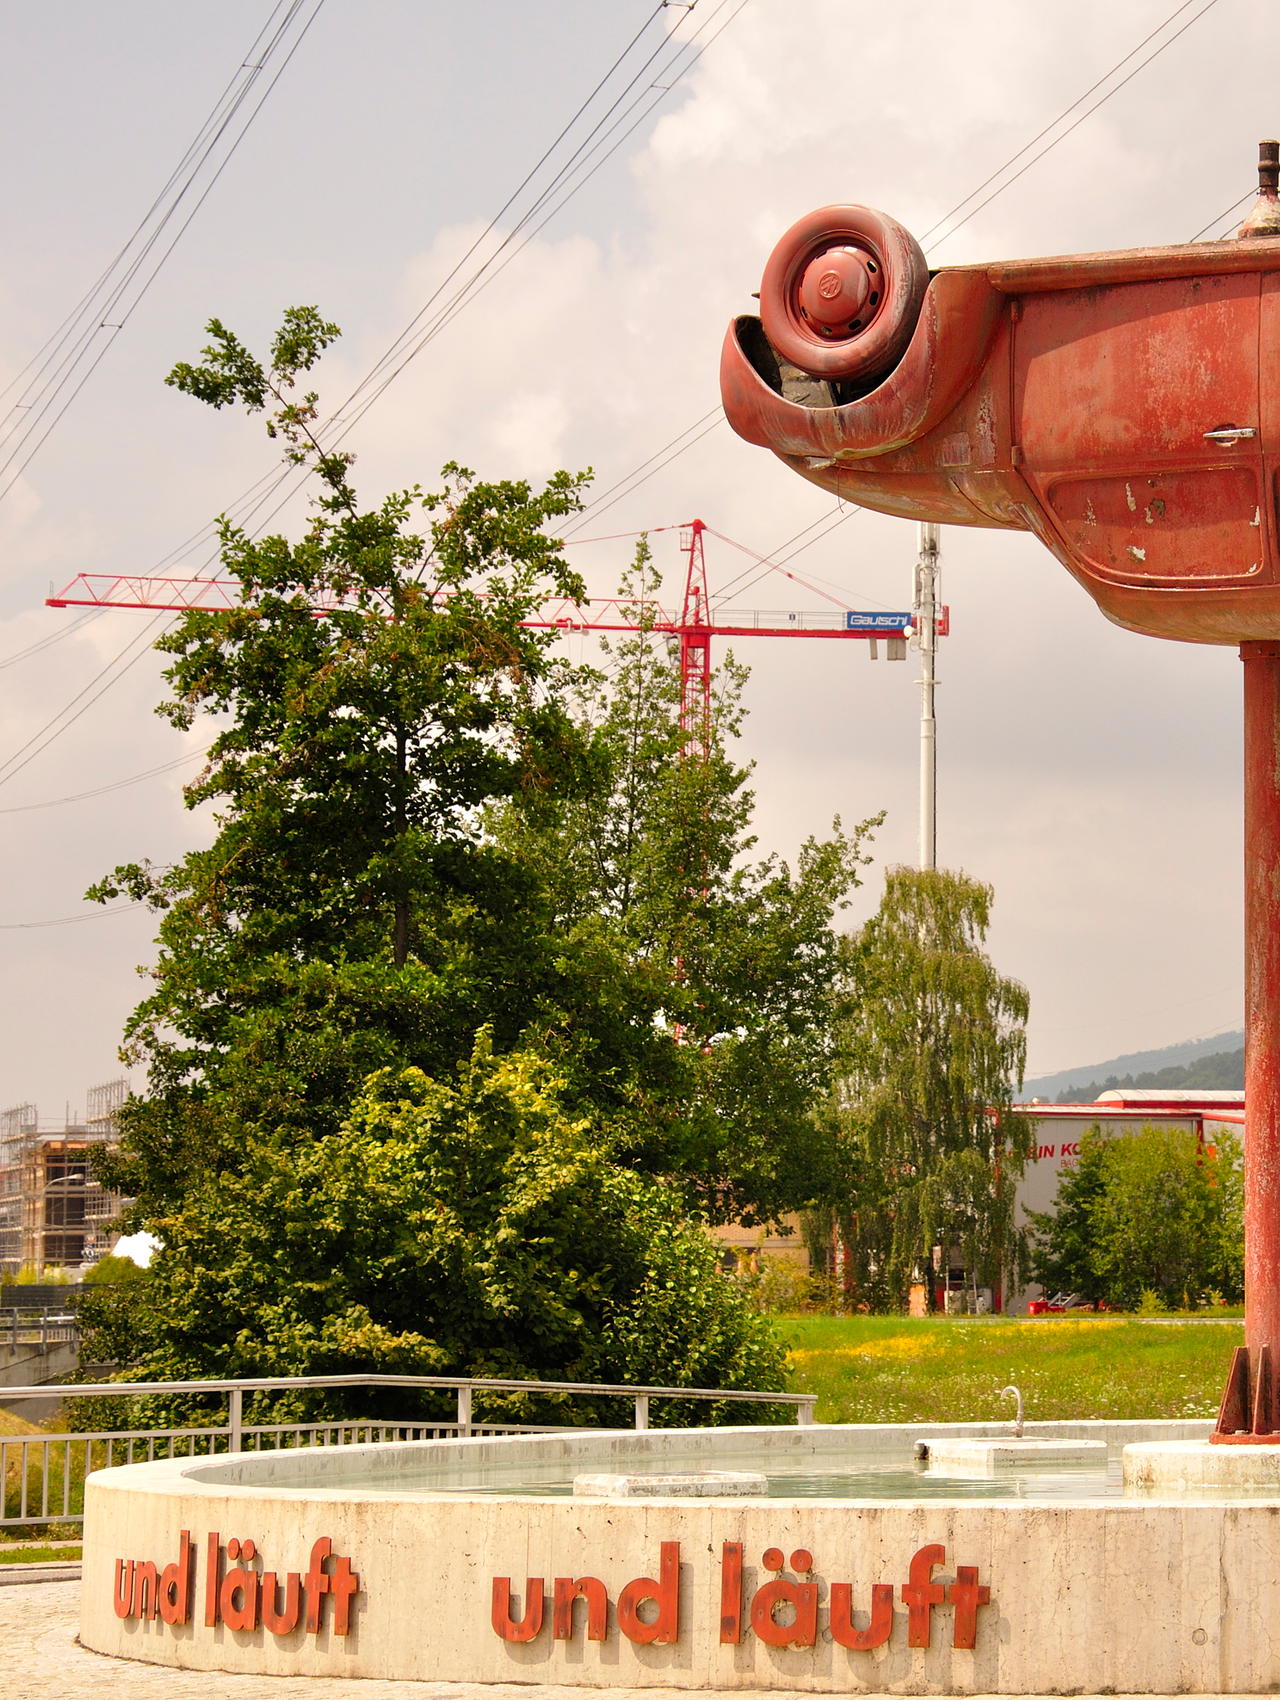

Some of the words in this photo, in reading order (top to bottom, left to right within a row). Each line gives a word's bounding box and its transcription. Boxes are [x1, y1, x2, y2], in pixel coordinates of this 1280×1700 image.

[850, 615, 908, 626] Gautschi
[113, 1529, 191, 1626] und
[204, 1532, 359, 1636] läuft
[492, 1541, 680, 1644] und
[720, 1542, 991, 1650] läuft
